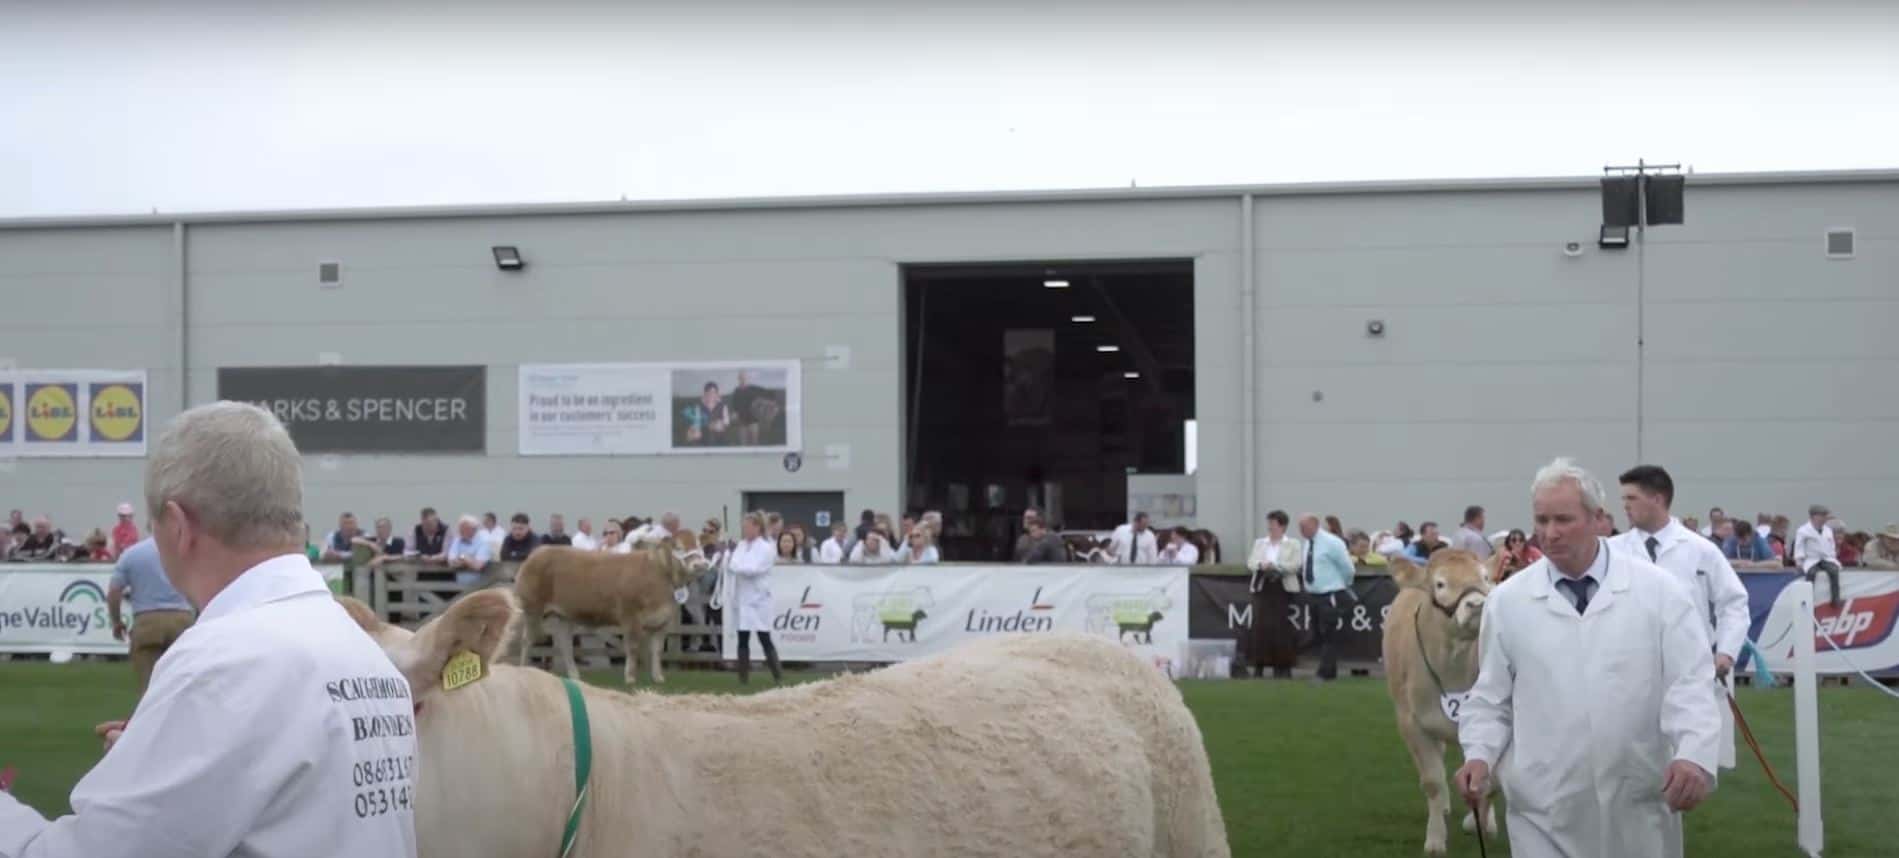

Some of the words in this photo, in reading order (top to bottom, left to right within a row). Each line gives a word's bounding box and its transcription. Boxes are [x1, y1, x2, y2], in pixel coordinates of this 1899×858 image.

[259, 399, 321, 421] RKS
[325, 399, 342, 421] &
[346, 398, 467, 421] SPENCER
[23, 606, 90, 635] Valley
[965, 608, 1053, 632] Linden
[1351, 604, 1373, 631] &
